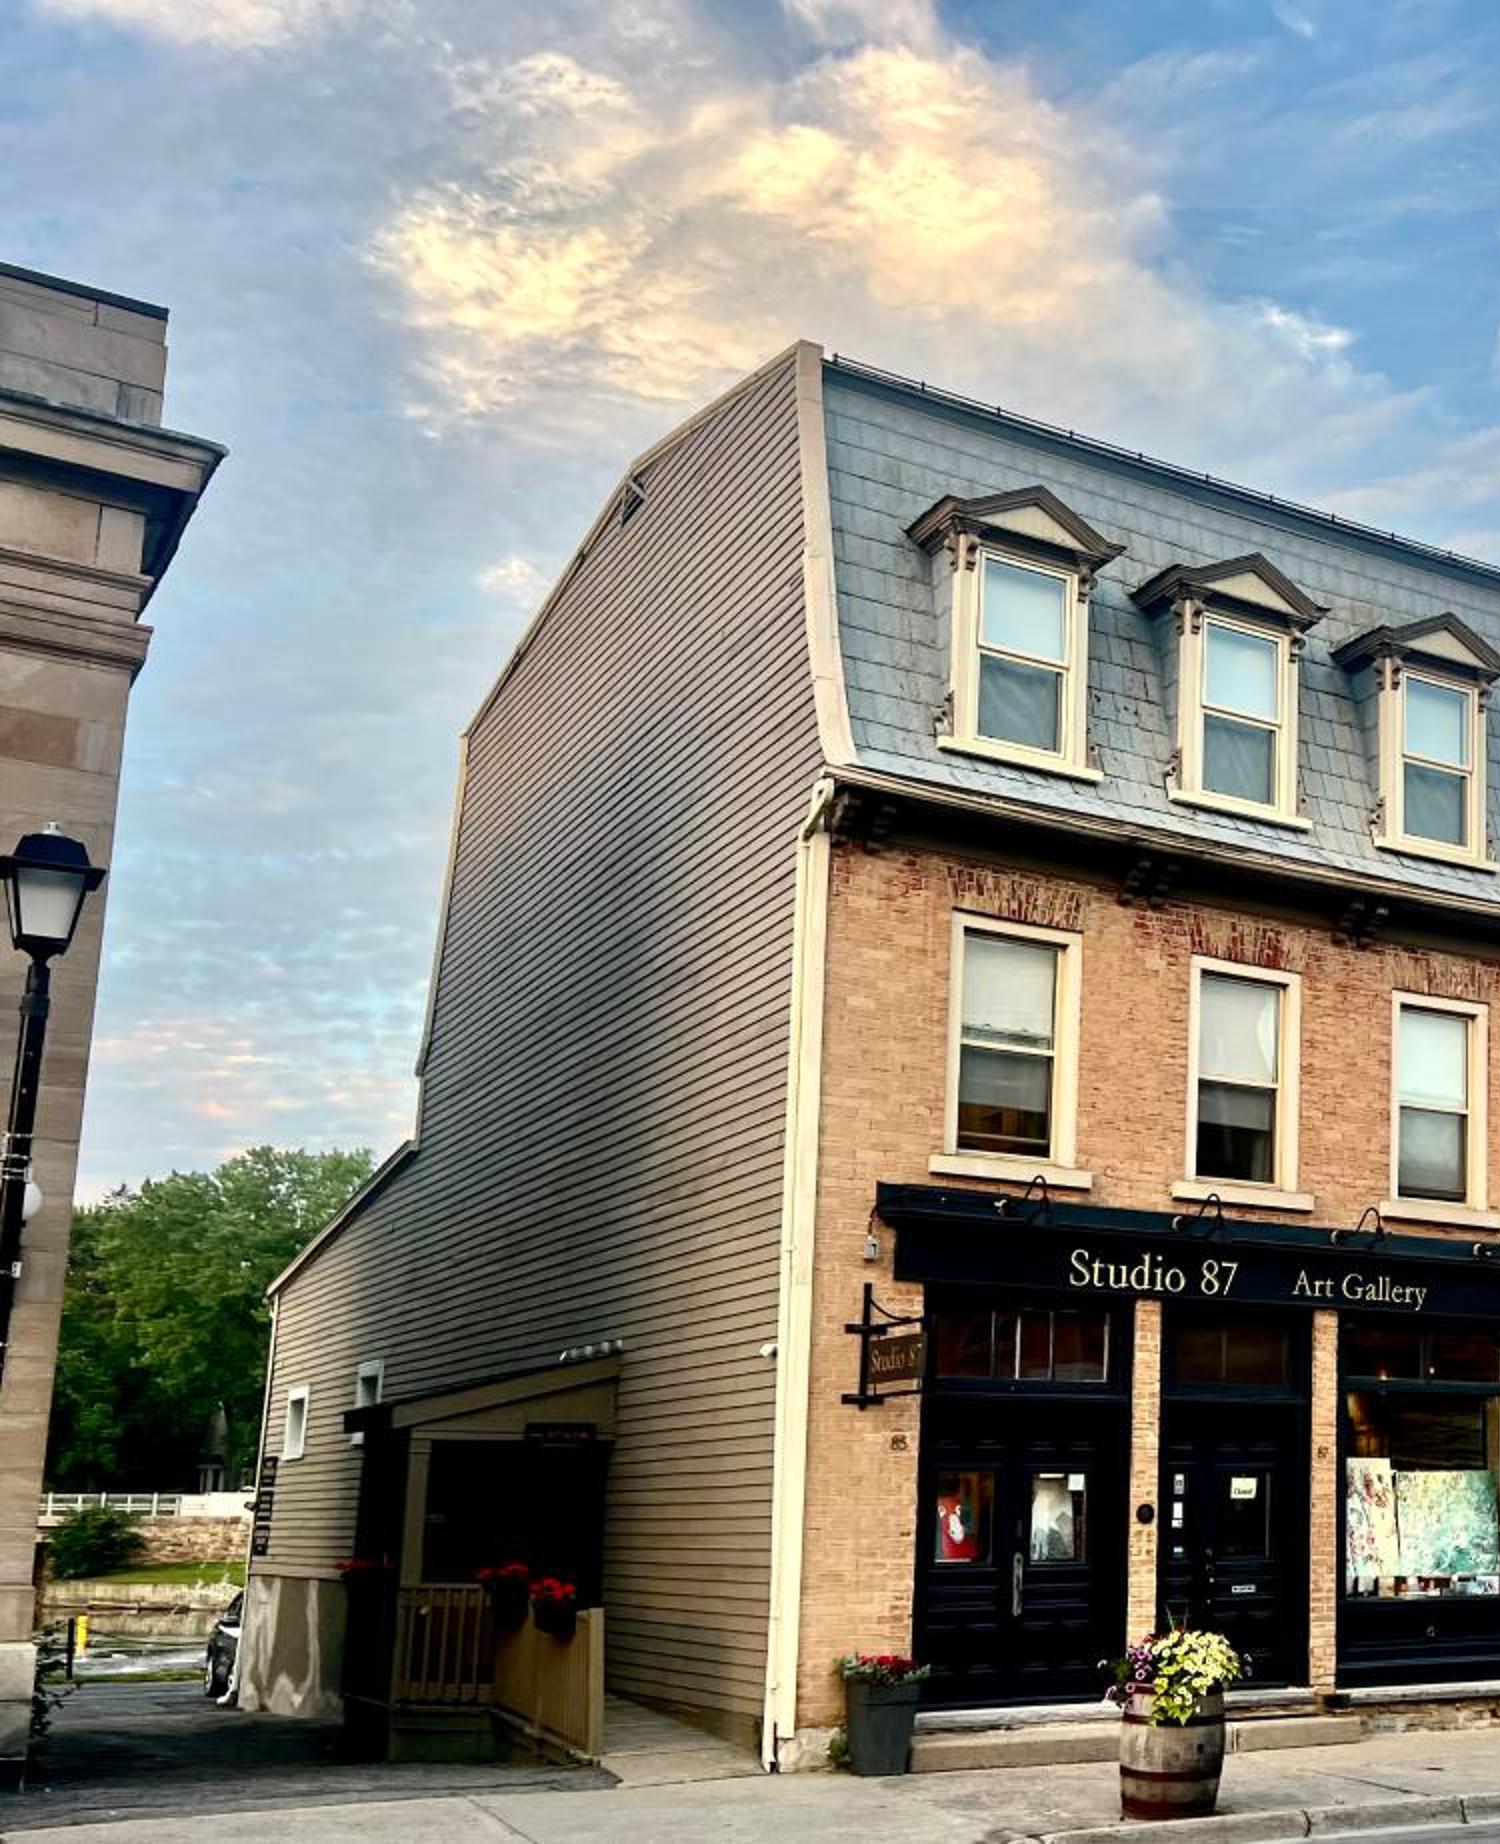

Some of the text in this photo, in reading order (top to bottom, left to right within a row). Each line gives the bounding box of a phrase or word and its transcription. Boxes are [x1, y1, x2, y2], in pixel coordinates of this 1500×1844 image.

[1069, 1249, 1240, 1296] Studio 87
[1291, 1269, 1428, 1312] Art Gallery
